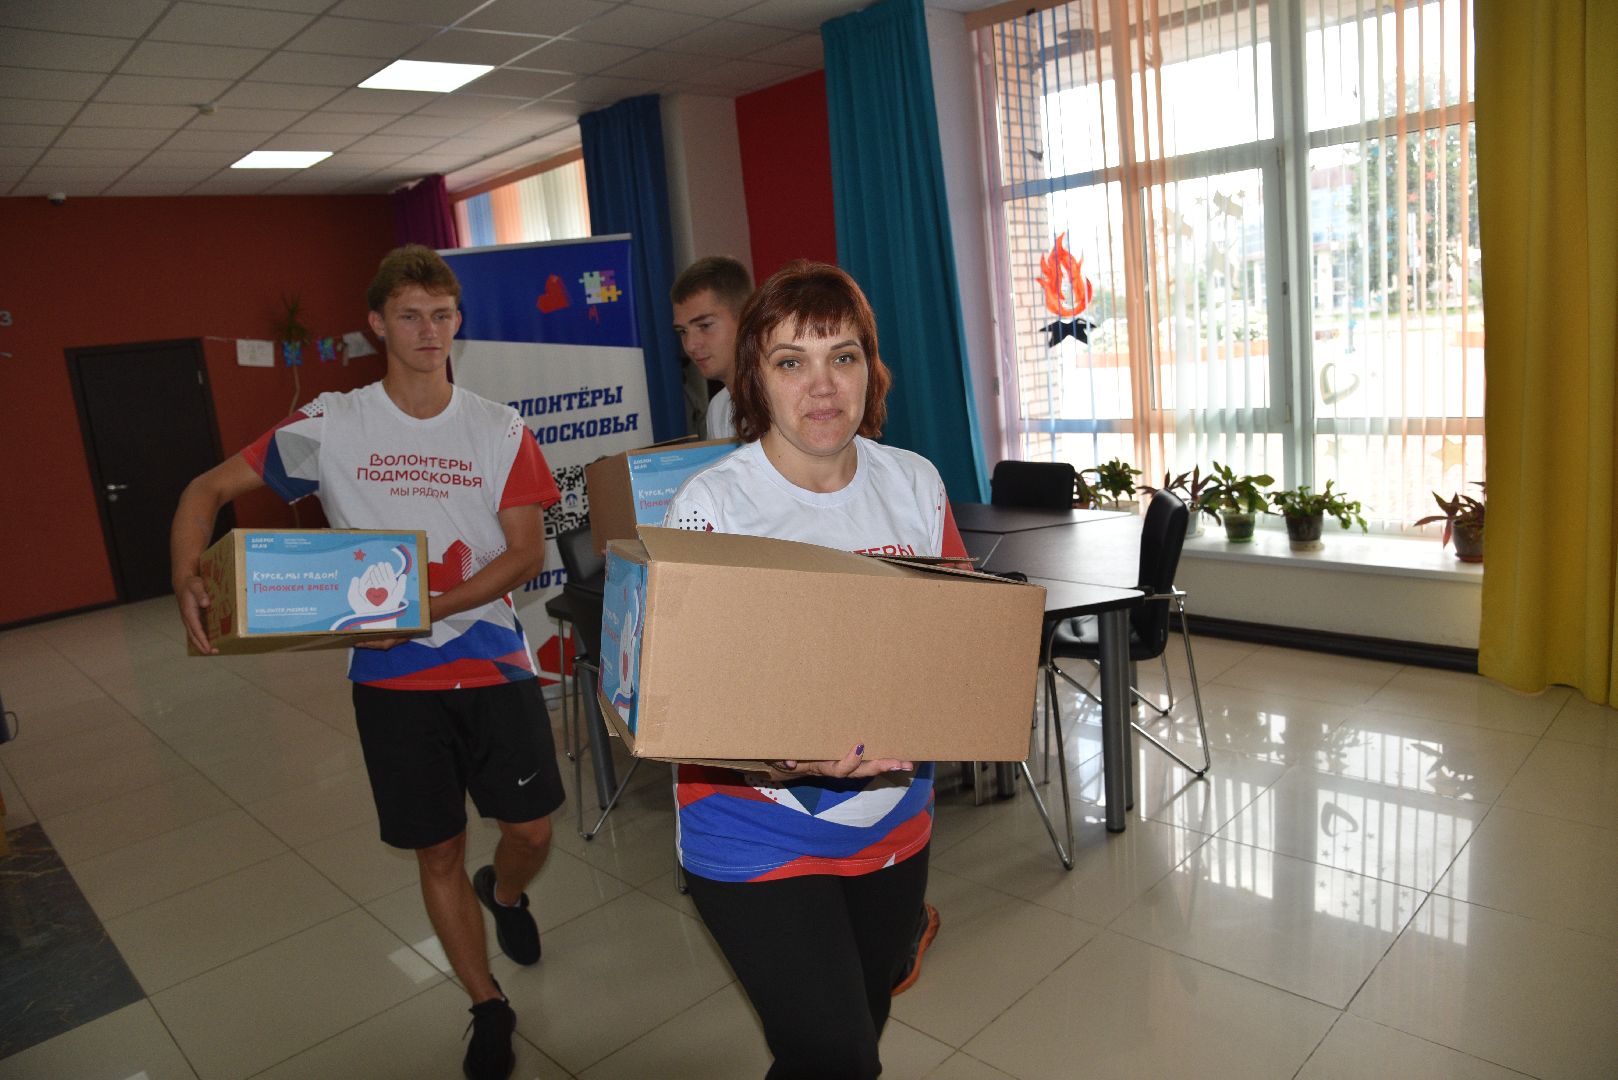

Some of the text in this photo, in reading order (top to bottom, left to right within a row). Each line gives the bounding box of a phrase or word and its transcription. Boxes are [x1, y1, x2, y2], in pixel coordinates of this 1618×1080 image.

[502, 386, 623, 418] ЛОНТЁРЫ
[369, 453, 473, 472] ВОЛОНТЕРЫ
[357, 467, 483, 488] ПОДМОСКОВЬЯ
[390, 487, 449, 499] МЫ РЯДОМ
